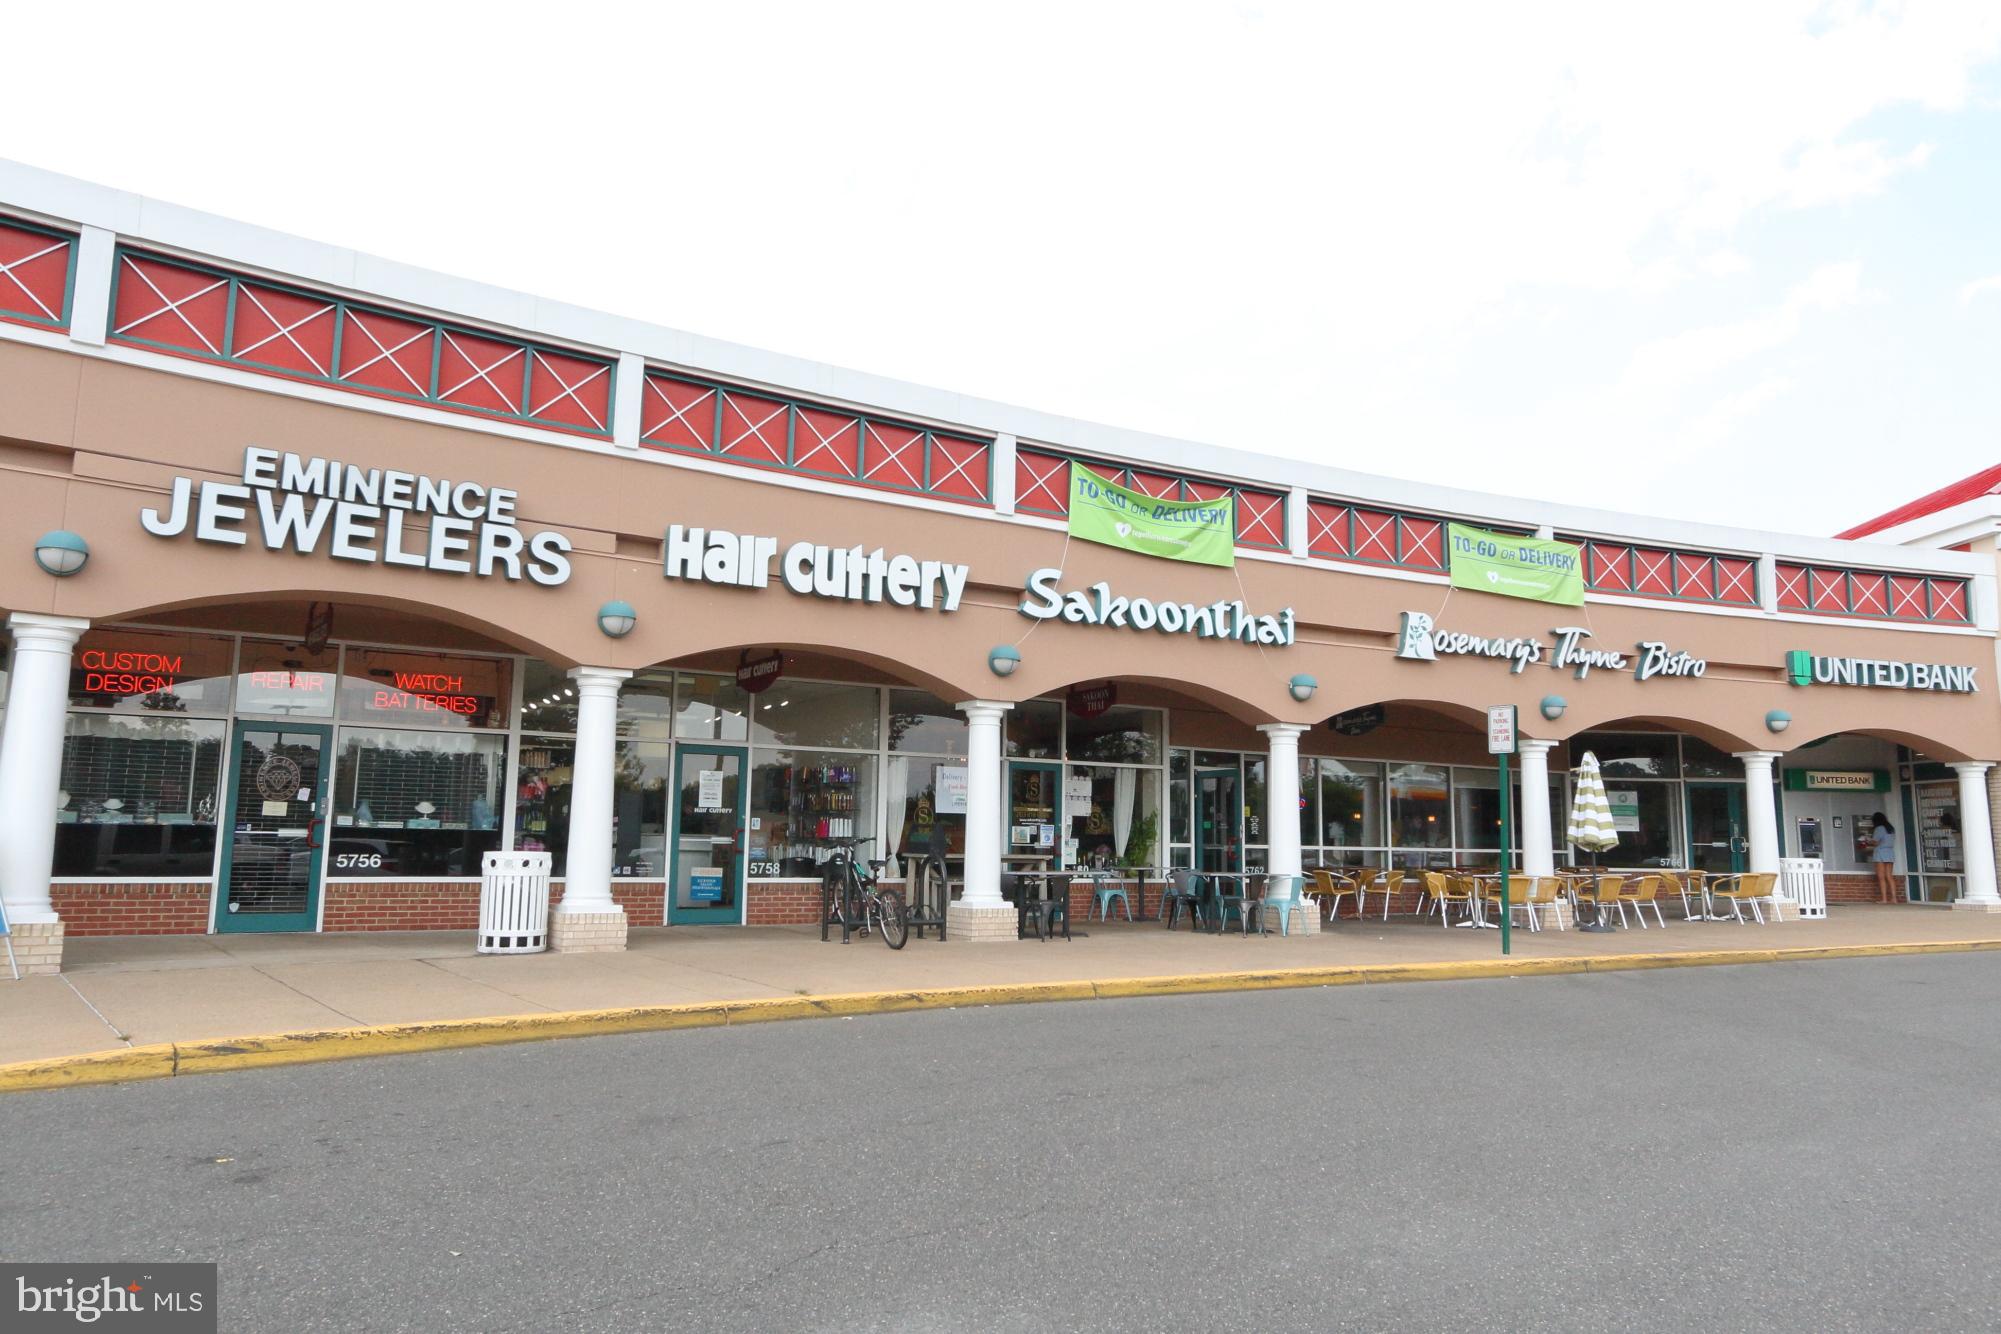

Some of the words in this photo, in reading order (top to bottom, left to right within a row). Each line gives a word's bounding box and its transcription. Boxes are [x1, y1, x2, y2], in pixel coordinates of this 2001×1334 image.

[244, 446, 518, 525] EMINENCE
[1077, 477, 1127, 509] TO-GO
[1131, 504, 1148, 516] OR
[1151, 505, 1227, 525] DELIVERY
[141, 476, 571, 586] JEWELERS
[664, 525, 777, 588] Hair
[1454, 536, 1497, 557] TO-GO
[1501, 549, 1516, 560] OR
[1519, 547, 1576, 571] DELIVERY
[1020, 568, 1296, 646] Sakoonthai
[1395, 611, 1541, 674] Rosemary's
[1552, 627, 1627, 680] Thyme
[1637, 641, 1706, 680] Bistro
[82, 650, 182, 673] CUSTOM
[1813, 656, 1909, 687] UNITED
[1912, 663, 1979, 692] BANK
[85, 673, 174, 694] DESIGN
[251, 671, 324, 692] REPAIR
[395, 672, 463, 692] WATCH
[373, 691, 478, 714] BATTERIES
[1816, 776, 1847, 784] UNITED
[1848, 776, 1871, 784] BANK
[336, 854, 381, 868] 5756
[750, 863, 780, 874] 5758
